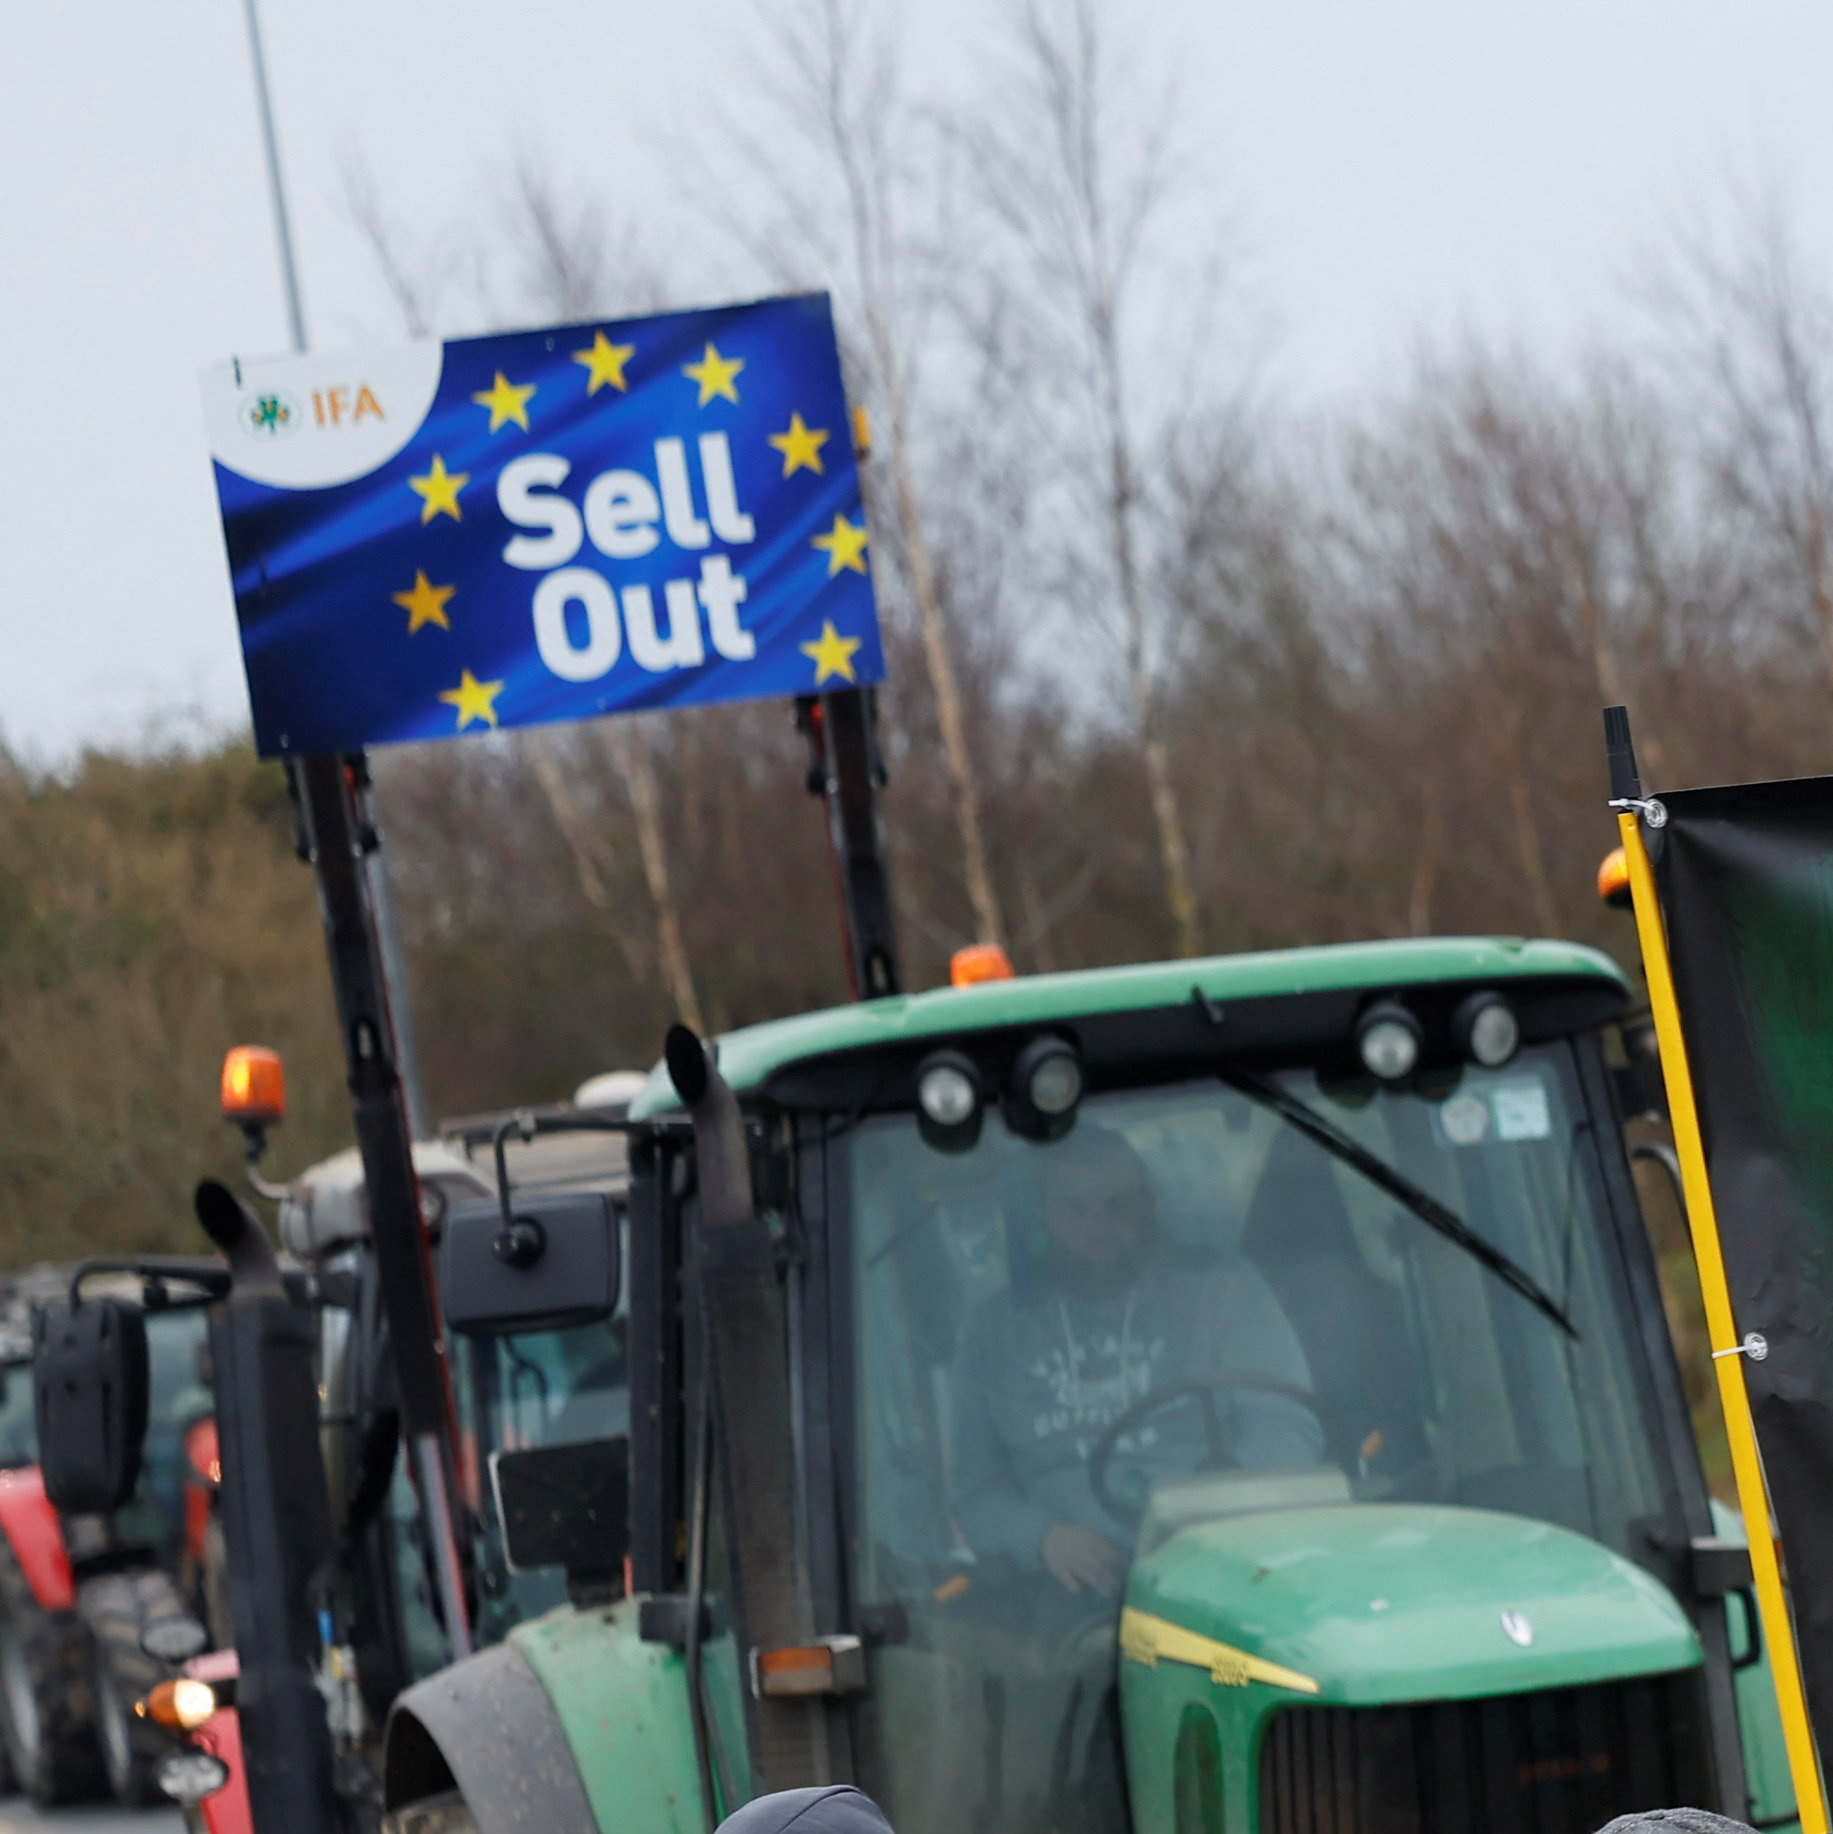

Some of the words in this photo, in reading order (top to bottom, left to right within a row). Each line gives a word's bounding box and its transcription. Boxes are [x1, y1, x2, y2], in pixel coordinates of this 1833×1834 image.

[312, 384, 386, 427] IFA
[496, 432, 755, 569] Sell
[531, 555, 756, 681] Out
